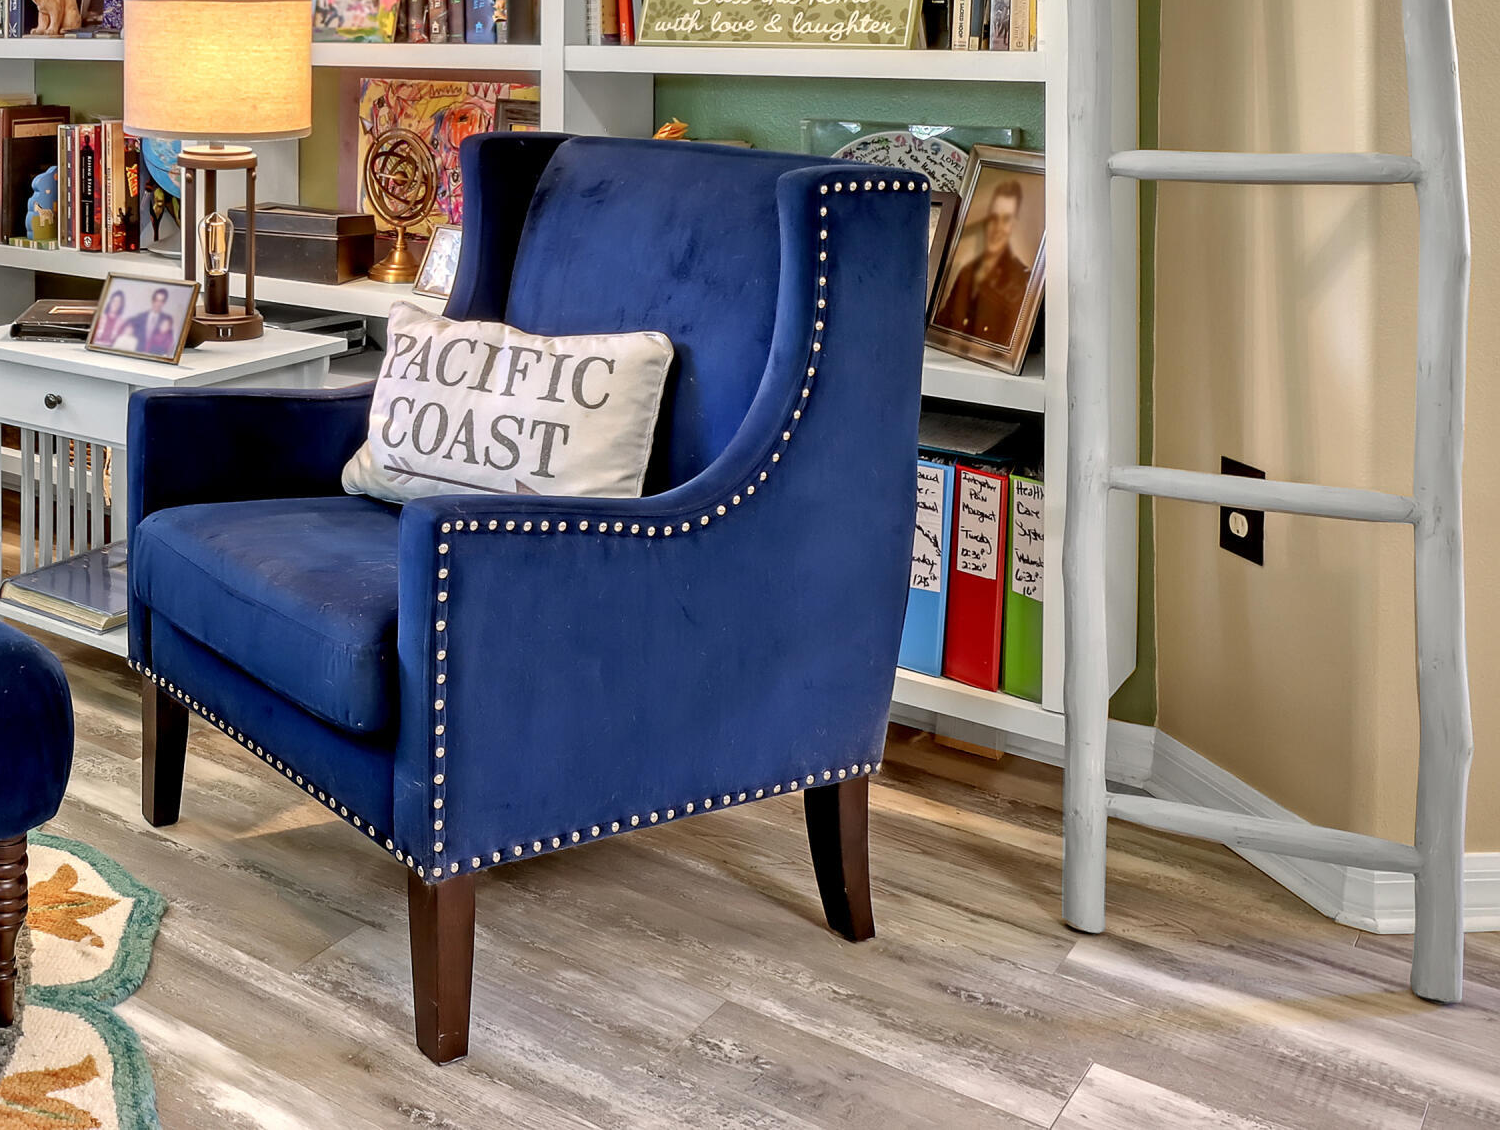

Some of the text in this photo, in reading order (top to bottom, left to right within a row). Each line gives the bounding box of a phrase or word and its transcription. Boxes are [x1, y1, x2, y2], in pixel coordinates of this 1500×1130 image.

[654, 10, 897, 41] with love & laughter
[941, 154, 964, 172] LOVE!
[125, 164, 138, 198] X-MEN
[382, 332, 616, 410] PACIFIC
[381, 396, 570, 478] COAST
[969, 488, 987, 502] Pain
[1016, 501, 1040, 519] Care
